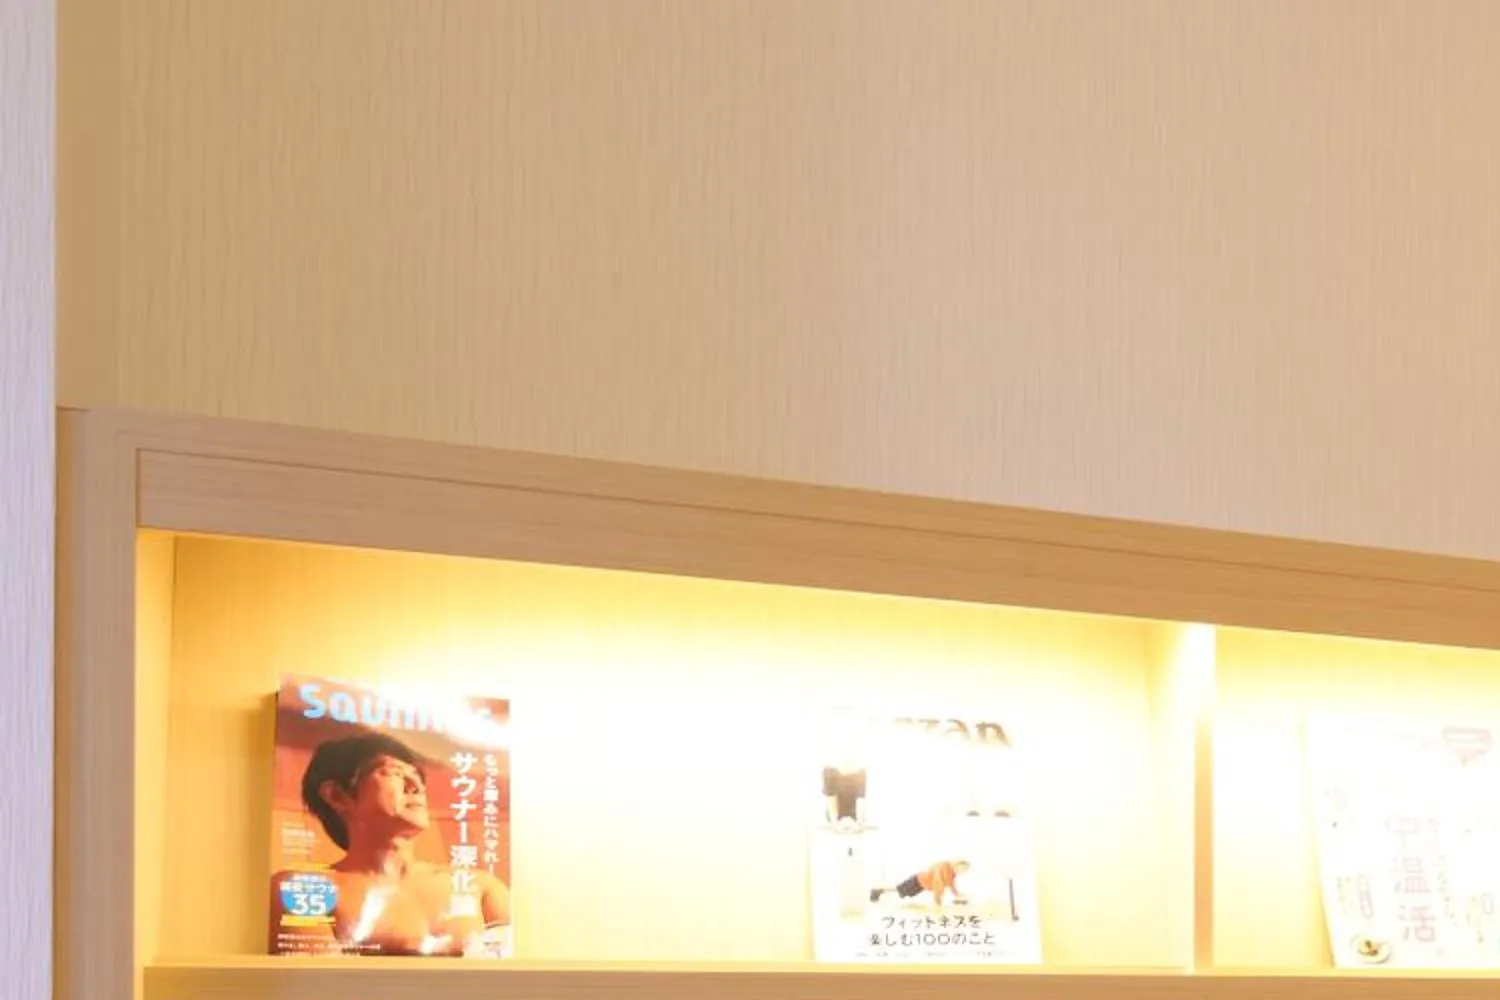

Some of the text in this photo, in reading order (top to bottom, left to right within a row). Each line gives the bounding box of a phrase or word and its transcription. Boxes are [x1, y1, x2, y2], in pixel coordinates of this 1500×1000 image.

[291, 894, 326, 917] 35
[881, 915, 983, 930] フィットネスを
[868, 931, 997, 947] 楽しむ100のこと
